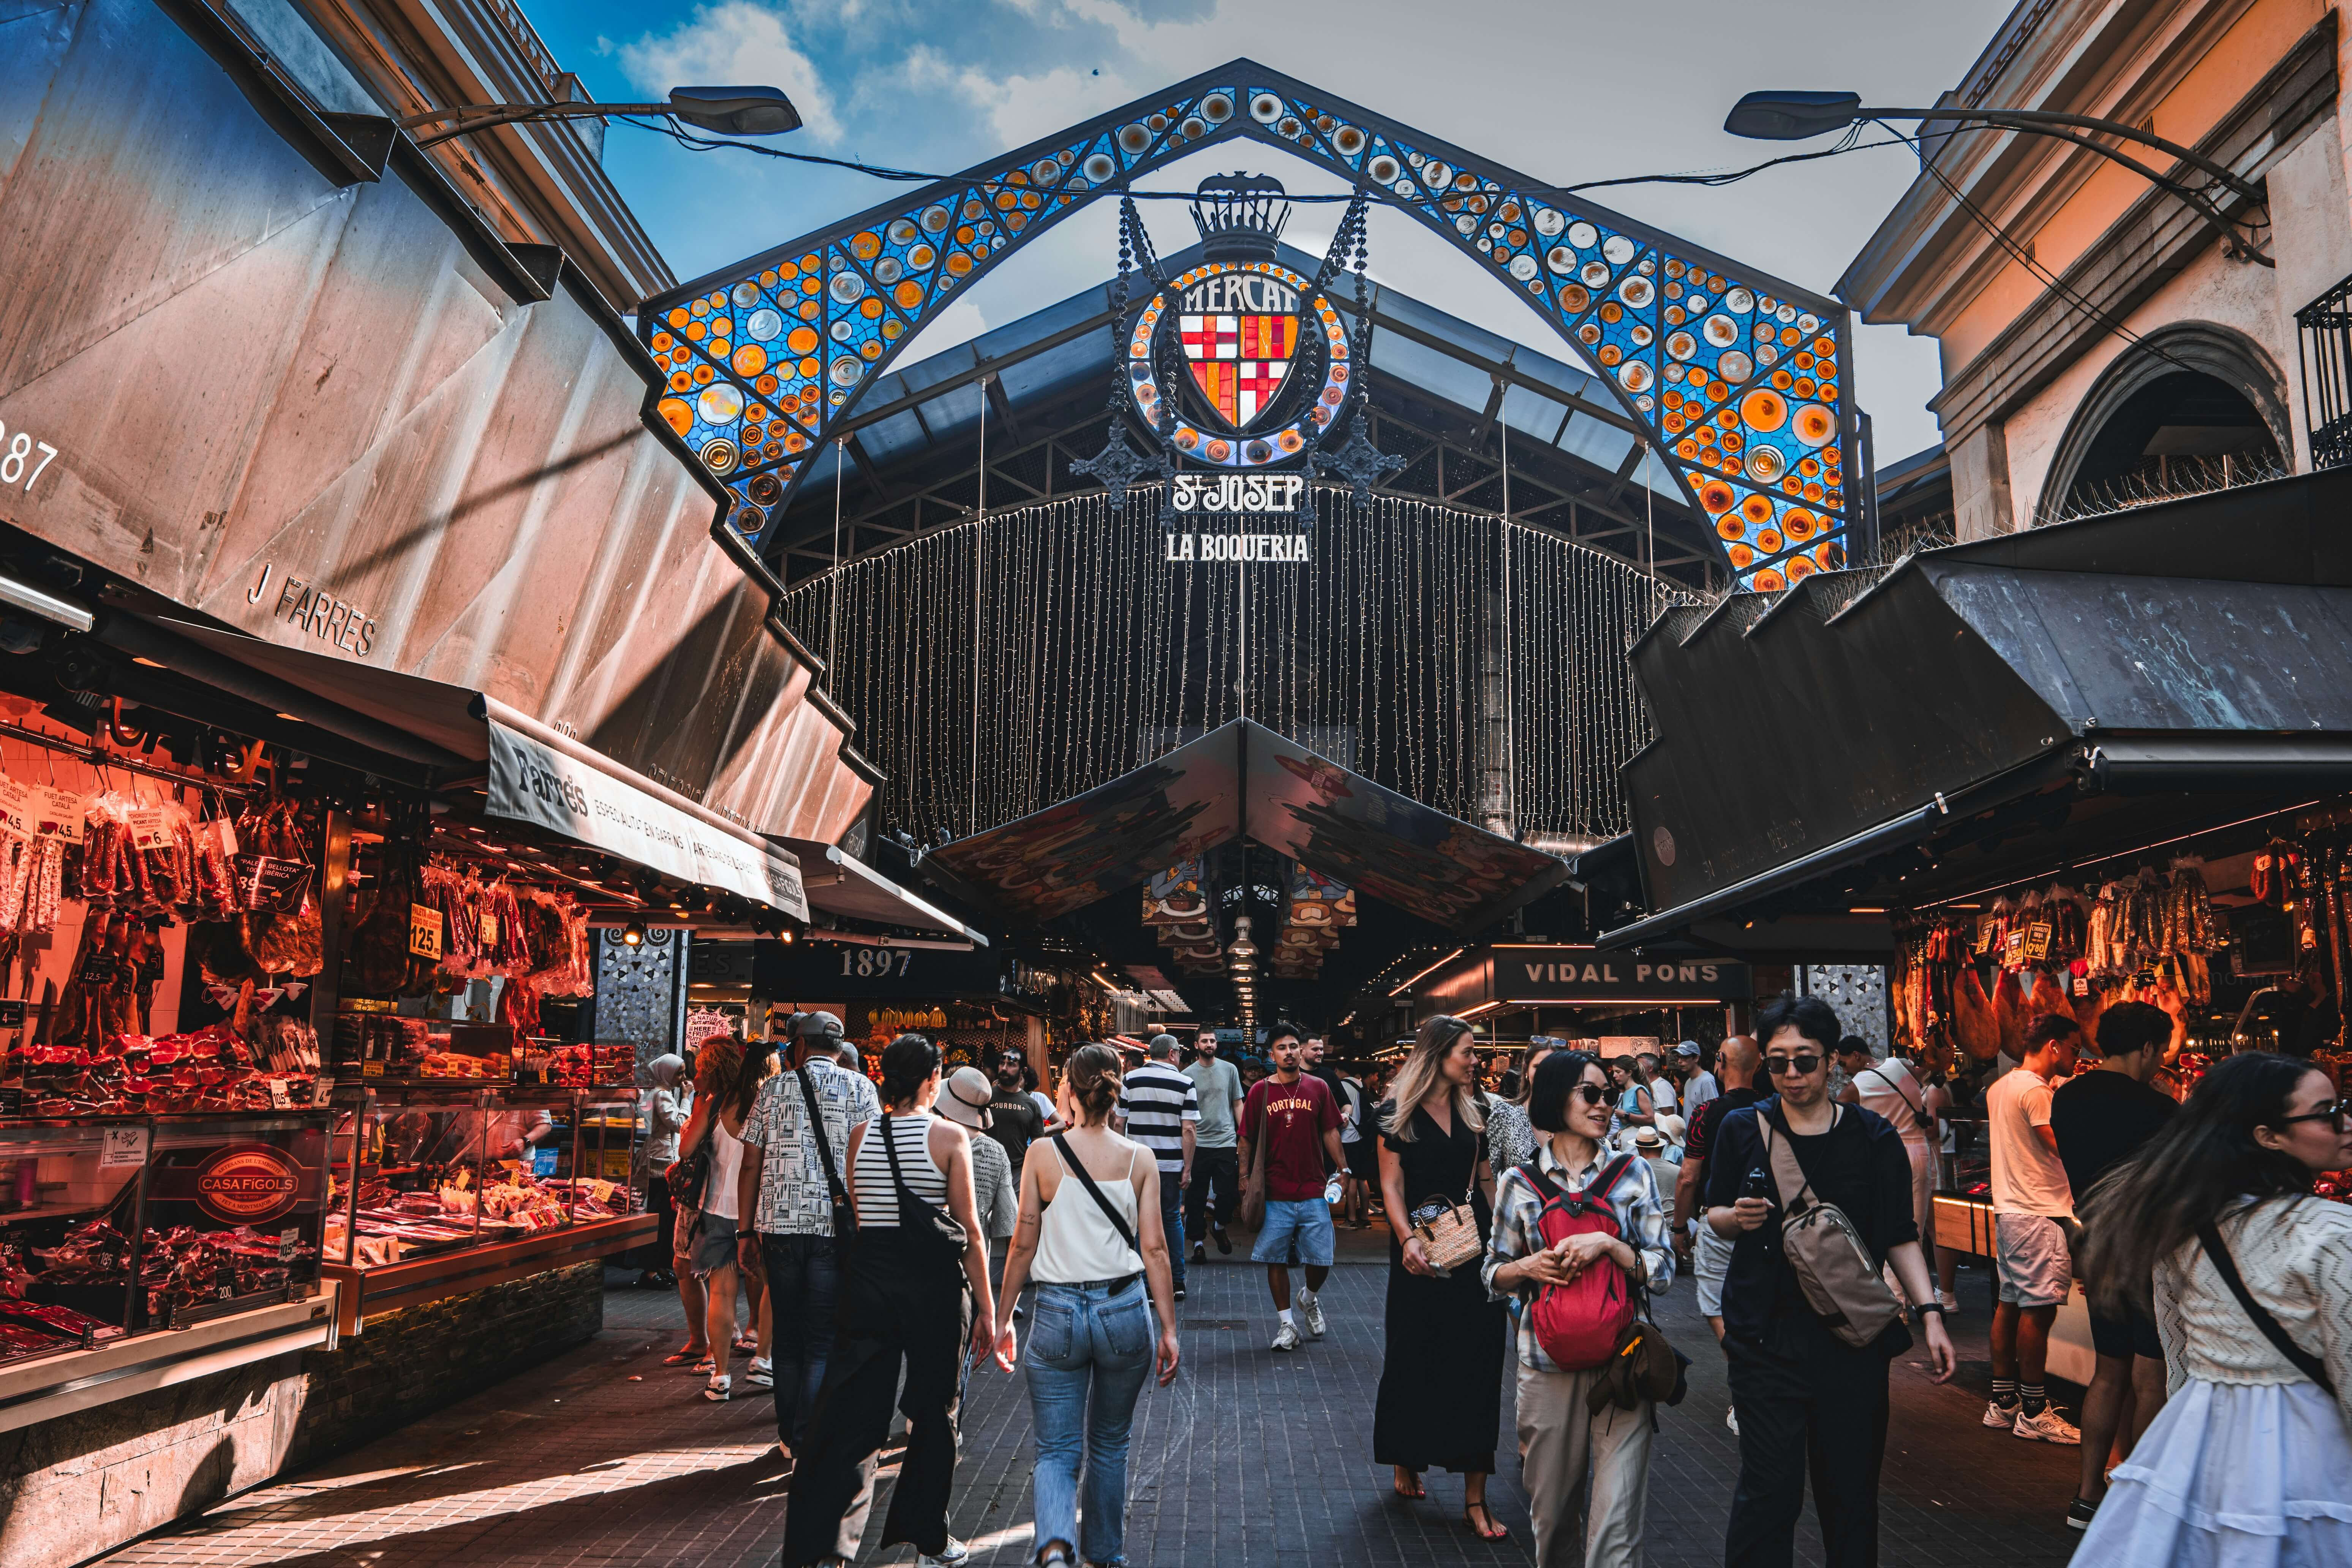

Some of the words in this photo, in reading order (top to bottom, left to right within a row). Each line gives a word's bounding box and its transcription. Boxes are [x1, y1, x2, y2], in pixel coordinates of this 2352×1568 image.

[1185, 275, 1296, 312] MERCAT
[0, 419, 58, 494] 87
[1203, 475, 1304, 512] JOSEP
[1167, 534, 1194, 561] LA
[1201, 534, 1309, 562] BOQUERIA
[249, 563, 272, 604] J
[276, 575, 377, 657] FARRES
[44, 792, 57, 800] FUET
[58, 794, 77, 805] ARTESÀ
[52, 801, 71, 810] CATALÀ
[8, 815, 21, 830] 4,5
[58, 824, 72, 838] 4,5
[153, 831, 162, 844] 6
[644, 822, 654, 839] EN
[240, 858, 266, 868] “PALEA
[413, 905, 426, 918] PALETA
[412, 916, 422, 925] CEBO
[429, 921, 441, 931] CAMPO
[411, 925, 434, 952] 125
[2027, 942, 2045, 955] 9'80
[840, 949, 912, 979] 1897
[85, 972, 101, 982] 12,5
[1525, 964, 1620, 982] VIDAL
[1636, 964, 1720, 982] PONS
[2, 1012, 8, 1023] 4
[273, 1093, 286, 1107] 10,5
[319, 1091, 324, 1103] 4
[1267, 1098, 1312, 1116] PORTUGAL
[218, 1159, 244, 1174] ARTESANS
[254, 1159, 281, 1174] L'EMBOTIT
[202, 1179, 240, 1190] CASA
[237, 1199, 272, 1209] MONTMAJOR
[3, 1244, 13, 1255] 32
[280, 1242, 292, 1258] 10,5
[218, 1285, 232, 1299] 200
